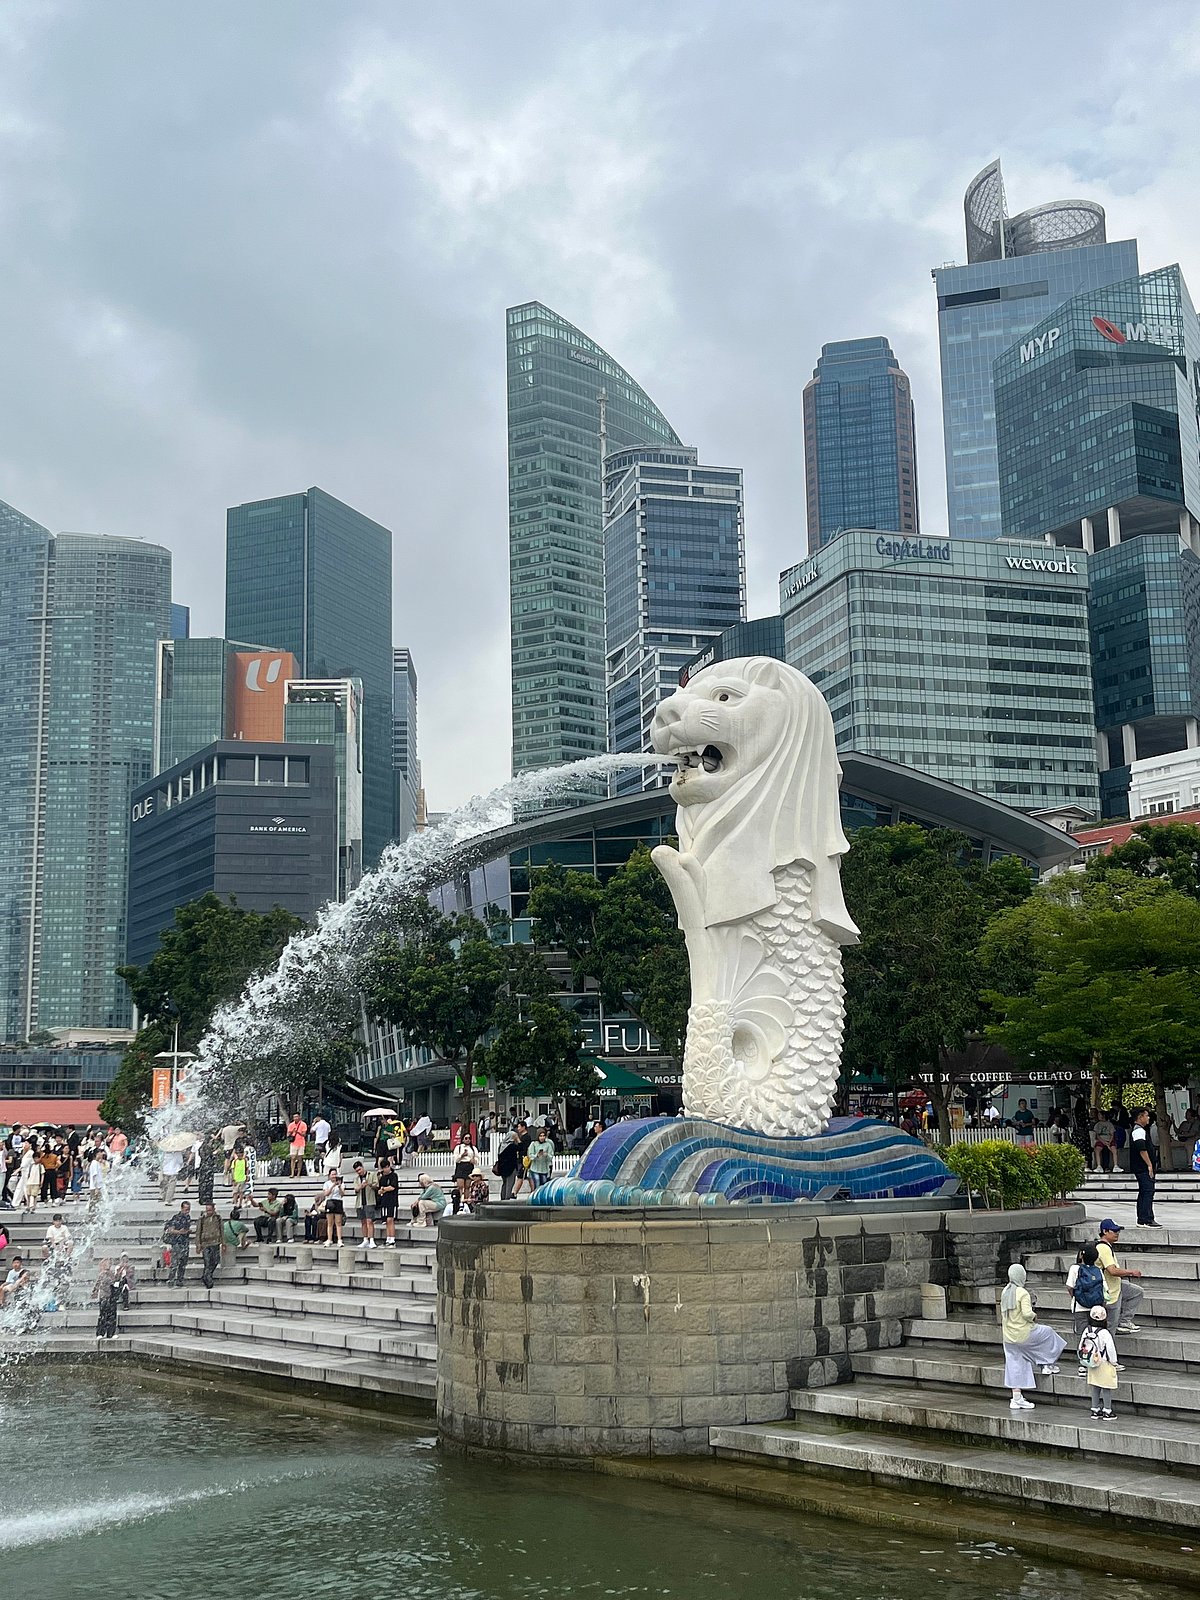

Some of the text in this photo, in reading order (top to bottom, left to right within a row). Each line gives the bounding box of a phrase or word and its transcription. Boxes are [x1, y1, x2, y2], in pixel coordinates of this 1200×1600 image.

[1125, 322, 1178, 342] MYP
[1019, 327, 1061, 365] MYP
[570, 350, 598, 367] Keppel
[875, 536, 951, 561] CapitaLand
[1005, 555, 1079, 574] wework
[784, 561, 819, 600] wework
[604, 1024, 660, 1053] FUL
[654, 1075, 677, 1084] MOS
[970, 1072, 1012, 1082] COFFEE
[1029, 1071, 1073, 1082] GELATO
[1080, 1069, 1107, 1080] BER
